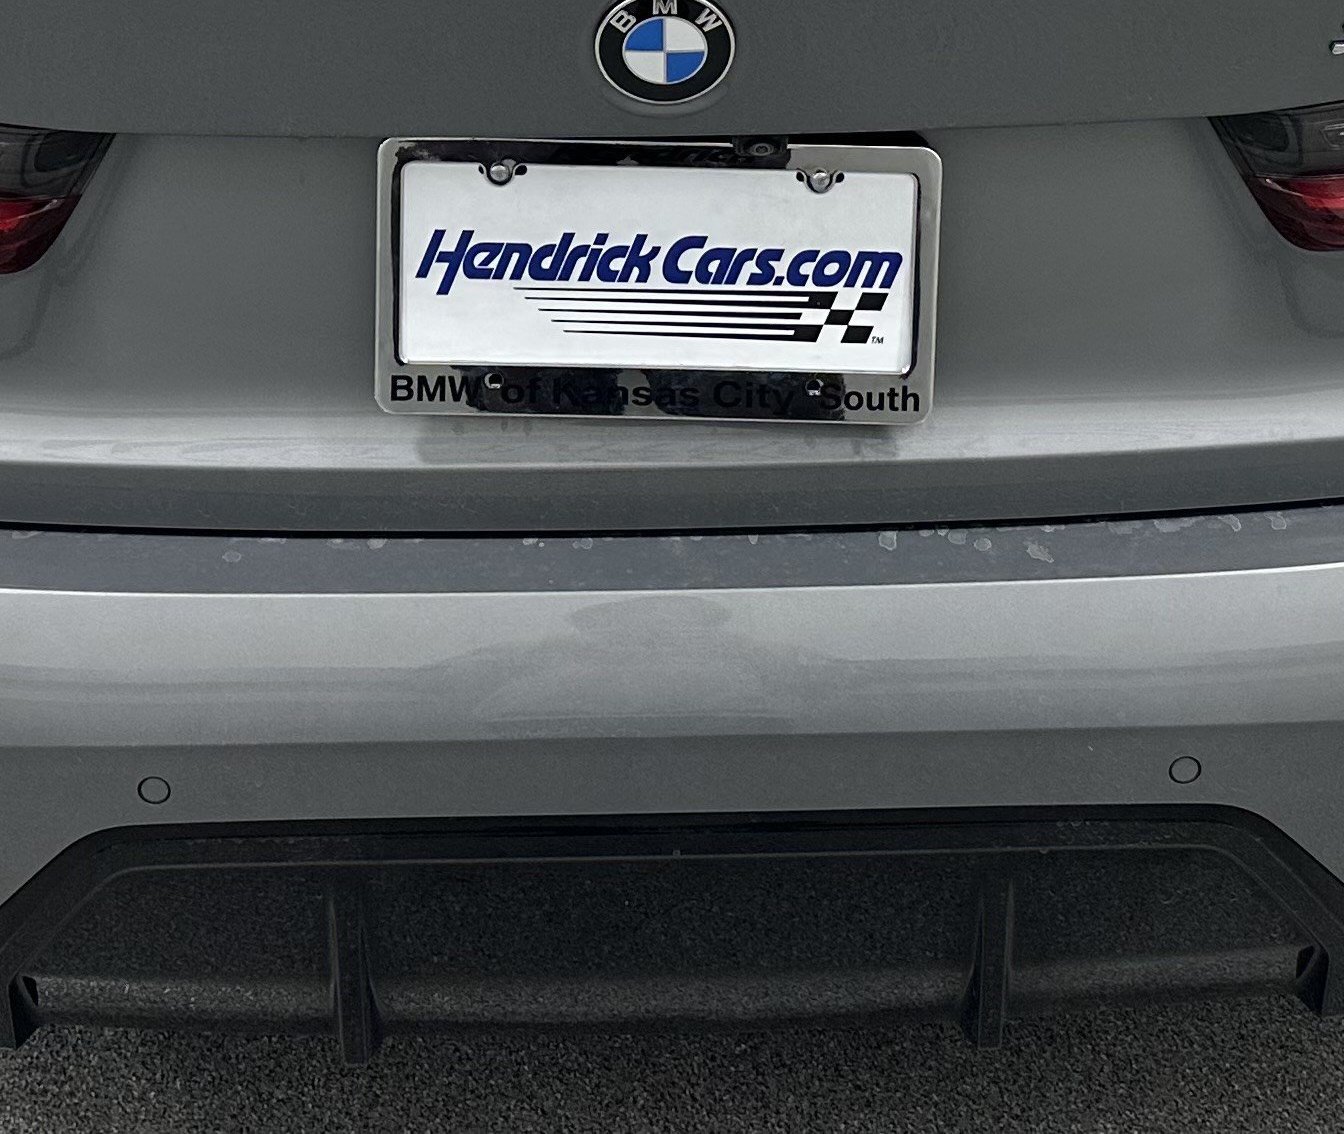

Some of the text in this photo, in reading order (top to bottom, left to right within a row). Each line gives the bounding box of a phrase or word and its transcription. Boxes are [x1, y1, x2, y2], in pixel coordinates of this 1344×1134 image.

[390, 374, 920, 415] BMW of Kansas City South
